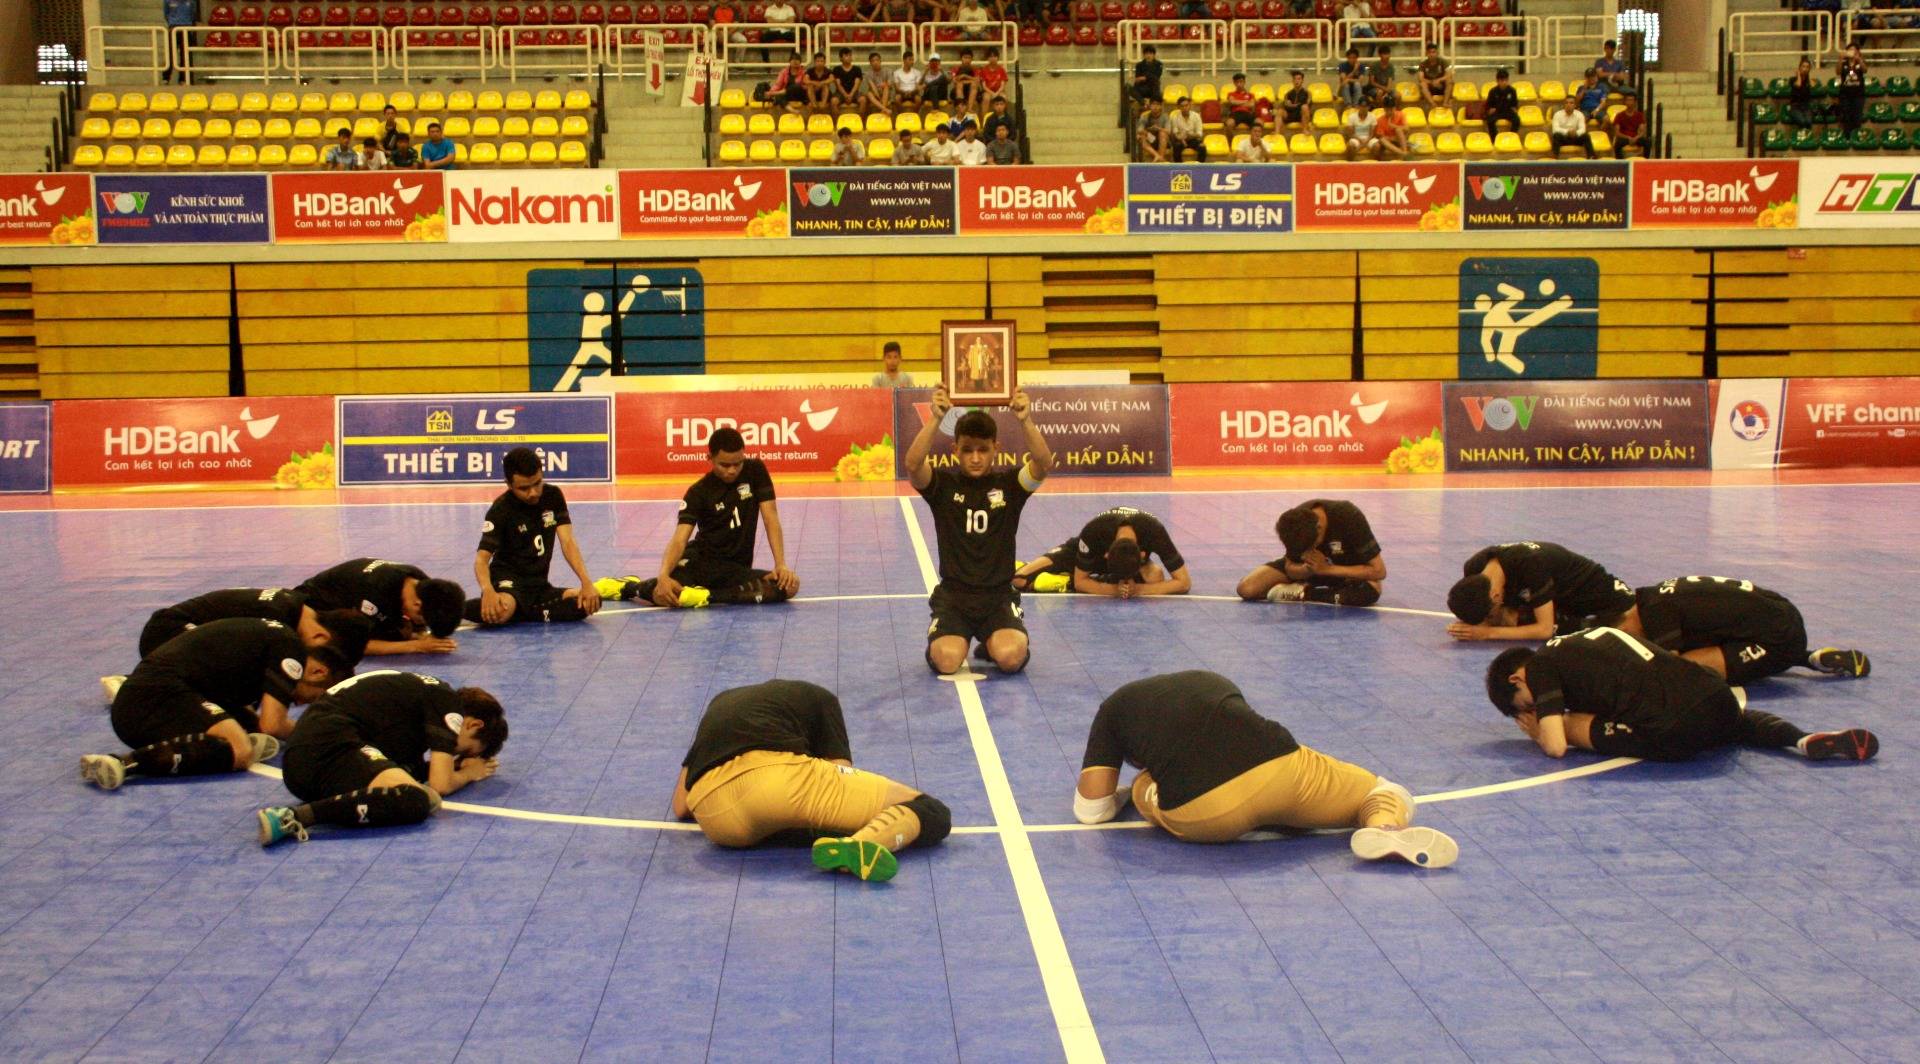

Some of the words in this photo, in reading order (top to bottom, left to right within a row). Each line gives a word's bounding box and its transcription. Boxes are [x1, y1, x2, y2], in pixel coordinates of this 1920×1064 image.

[849, 180, 865, 191] ĐÀI
[866, 178, 893, 191] TIẾNG
[894, 180, 909, 191] NÓI
[911, 179, 931, 192] VIỆT
[931, 181, 952, 190] NAM
[1173, 182, 1191, 190] TSN
[1209, 172, 1242, 191] LS
[1467, 175, 1521, 201] VOV
[1523, 175, 1540, 185] ĐÀI
[1541, 173, 1567, 185] TIẾNG
[1568, 174, 1583, 185] NÓI
[1584, 174, 1605, 186] VIỆT
[1606, 176, 1626, 185] NAM
[171, 194, 197, 208] KÊNH
[198, 193, 217, 208] SỨC
[638, 188, 736, 212] HDBank
[793, 181, 848, 207] VOV
[978, 185, 1077, 209] HDBank
[1314, 181, 1411, 205] HDBank
[1651, 179, 1750, 203] HDBank
[100, 191, 150, 215] VOV
[293, 191, 396, 217] HDBank
[450, 184, 614, 226] Nakami
[1315, 208, 1353, 217] Committed
[1355, 208, 1362, 217] to
[1380, 207, 1396, 216] best
[1651, 205, 1670, 215] Cam
[1720, 205, 1735, 214] cao
[295, 219, 313, 228] Cam
[365, 219, 381, 228] cao
[639, 214, 678, 224] Committed
[679, 215, 687, 223] to
[705, 213, 721, 222] best
[844, 219, 864, 230] TIN
[895, 214, 918, 229] HẤP
[979, 210, 998, 220] Cam
[1047, 211, 1063, 220] cao
[1136, 202, 1197, 226] THIẾT
[1203, 208, 1223, 230] BỊ
[1229, 204, 1283, 229] ĐIỆN
[1517, 213, 1536, 223] TIN
[1567, 208, 1590, 223] HẤP
[1030, 396, 1061, 412] IẾNG
[1065, 397, 1087, 412] NÓI
[1089, 396, 1120, 413] VIỆT
[1121, 399, 1151, 412] NAM
[1544, 394, 1563, 408] ĐÀI
[1569, 392, 1606, 408] TIẾNG
[1608, 395, 1630, 408] NÓI
[1632, 393, 1661, 410] VIỆT
[1662, 396, 1692, 408] NAM
[475, 408, 517, 431] LS
[1220, 409, 1353, 439] HDBank
[1460, 395, 1540, 432] VOV
[1805, 403, 1847, 424] VFF
[428, 422, 451, 431] TSN
[1575, 418, 1663, 431] WWW.VOV.VN
[104, 425, 241, 456] HDBank
[1221, 441, 1245, 454] Cam
[1249, 440, 1269, 453] kết
[1273, 440, 1288, 455] lợi
[1292, 440, 1309, 453] ích
[1313, 443, 1334, 453] cao
[1338, 440, 1364, 452] nhất
[383, 445, 459, 474] THIẾT
[467, 451, 493, 478] BỊ
[667, 450, 709, 462] Committ
[760, 450, 781, 461] best
[784, 451, 819, 461] returns
[991, 451, 1017, 466] IN
[1066, 444, 1102, 466] HẤP
[1460, 446, 1531, 464] NHANH,
[1535, 446, 1563, 461] TIN
[1568, 443, 1605, 464] CẬY,
[1611, 439, 1645, 461] HẤP
[105, 459, 129, 471] Cam
[134, 457, 152, 471] kết
[158, 457, 173, 472] lợi
[178, 456, 194, 469] ích
[199, 459, 221, 470] cao
[225, 456, 252, 469] nhất
[966, 508, 989, 534] 10
[534, 534, 546, 557] 9
